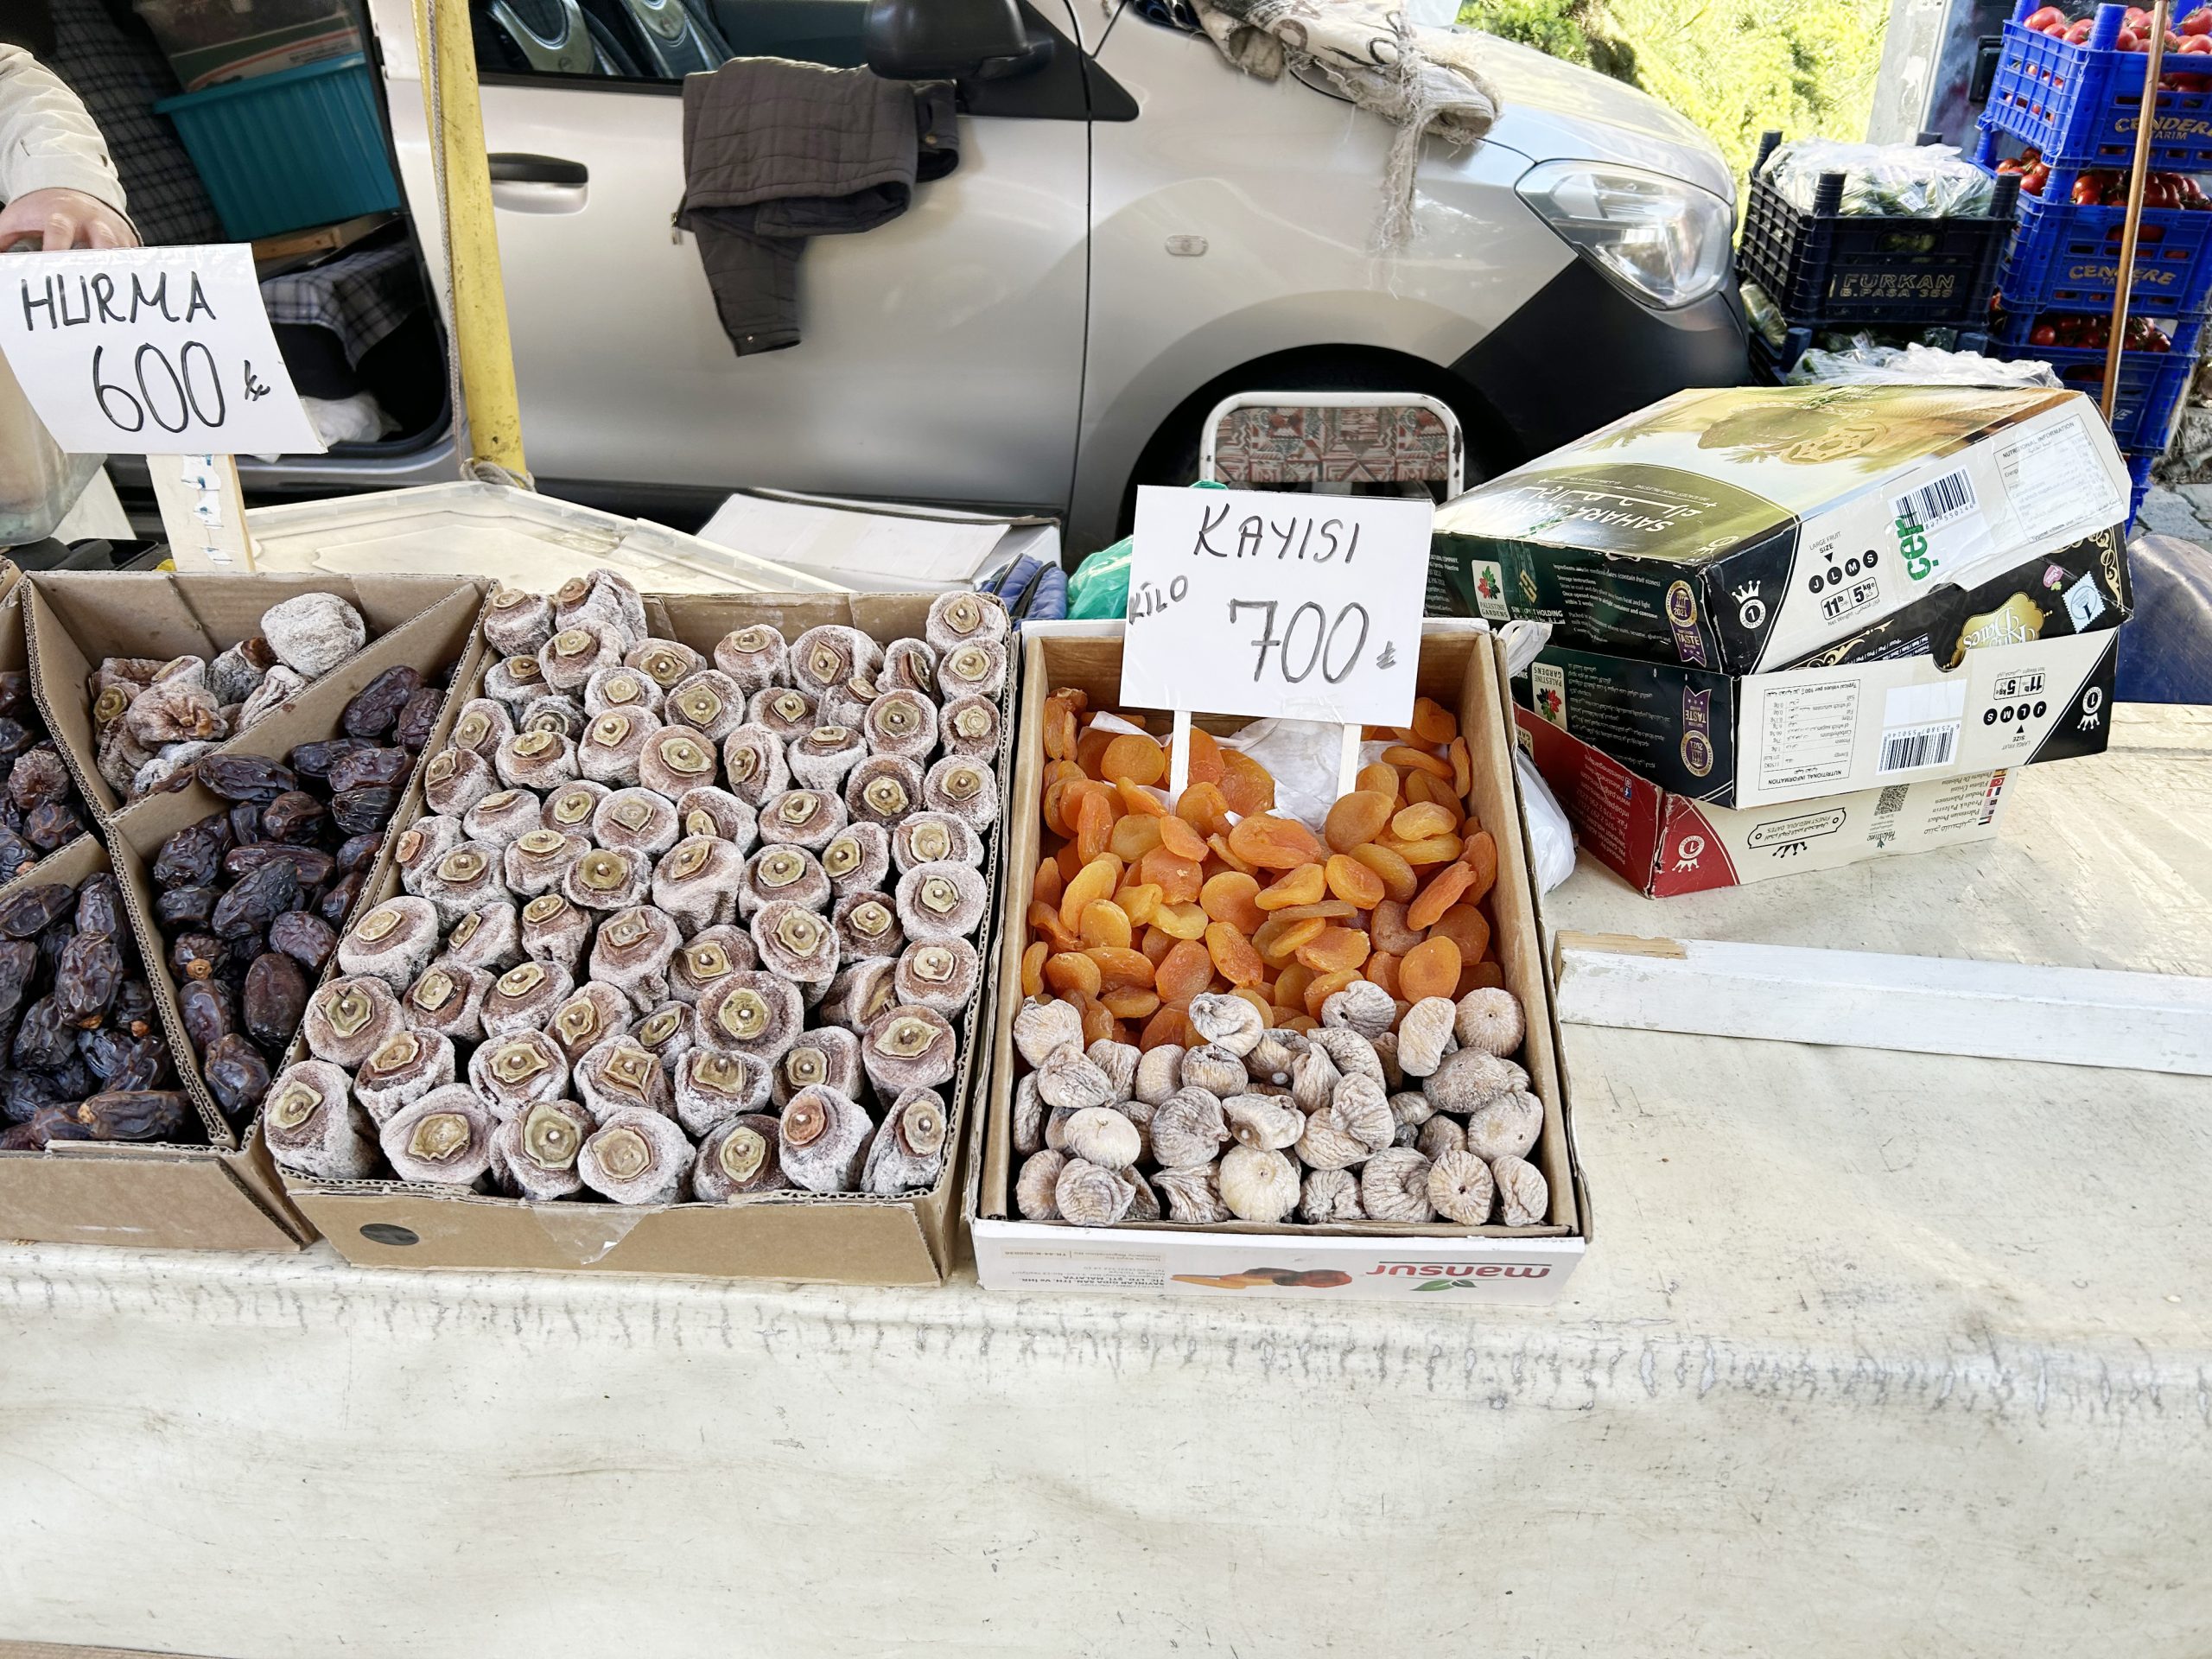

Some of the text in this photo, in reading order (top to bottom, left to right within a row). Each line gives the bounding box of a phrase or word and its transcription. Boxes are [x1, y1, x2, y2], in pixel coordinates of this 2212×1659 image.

[2151, 130, 2188, 140] ARIM
[1843, 273, 1955, 289] FURKAN
[2069, 265, 2177, 285] CENERE
[21, 270, 217, 331] HURMA
[92, 340, 226, 434] 600
[2002, 422, 2075, 458] NUTRITIONAL INFORMATION
[1193, 502, 1361, 564] KAYISI
[1809, 531, 1841, 550] LARGE FRUIT
[1895, 512, 1939, 582] çer
[1819, 543, 1834, 554] SIZE
[1479, 601, 1505, 611] PALESTINE
[1536, 608, 1563, 618] HOLDING
[1673, 607, 1688, 617] 2021
[1481, 609, 1509, 618] GARDENS
[1963, 607, 2019, 651] Dates
[1228, 597, 1370, 684] 700
[1676, 632, 1700, 645] TASTE
[1534, 666, 1563, 679] GARDENS
[1534, 674, 1562, 687] PALESTINE
[1840, 682, 1857, 690] Typical
[1684, 709, 1707, 724] TASTE
[1887, 729, 1917, 739] 550146
[1690, 741, 1704, 751] 2021
[1768, 769, 1842, 785] NUTRITIONAL INFORMATION
[1960, 799, 1982, 809] Produk
[1928, 808, 1980, 823] Palestinian Product
[1767, 824, 1785, 834] DATES
[1366, 1264, 1552, 1279] mansur
